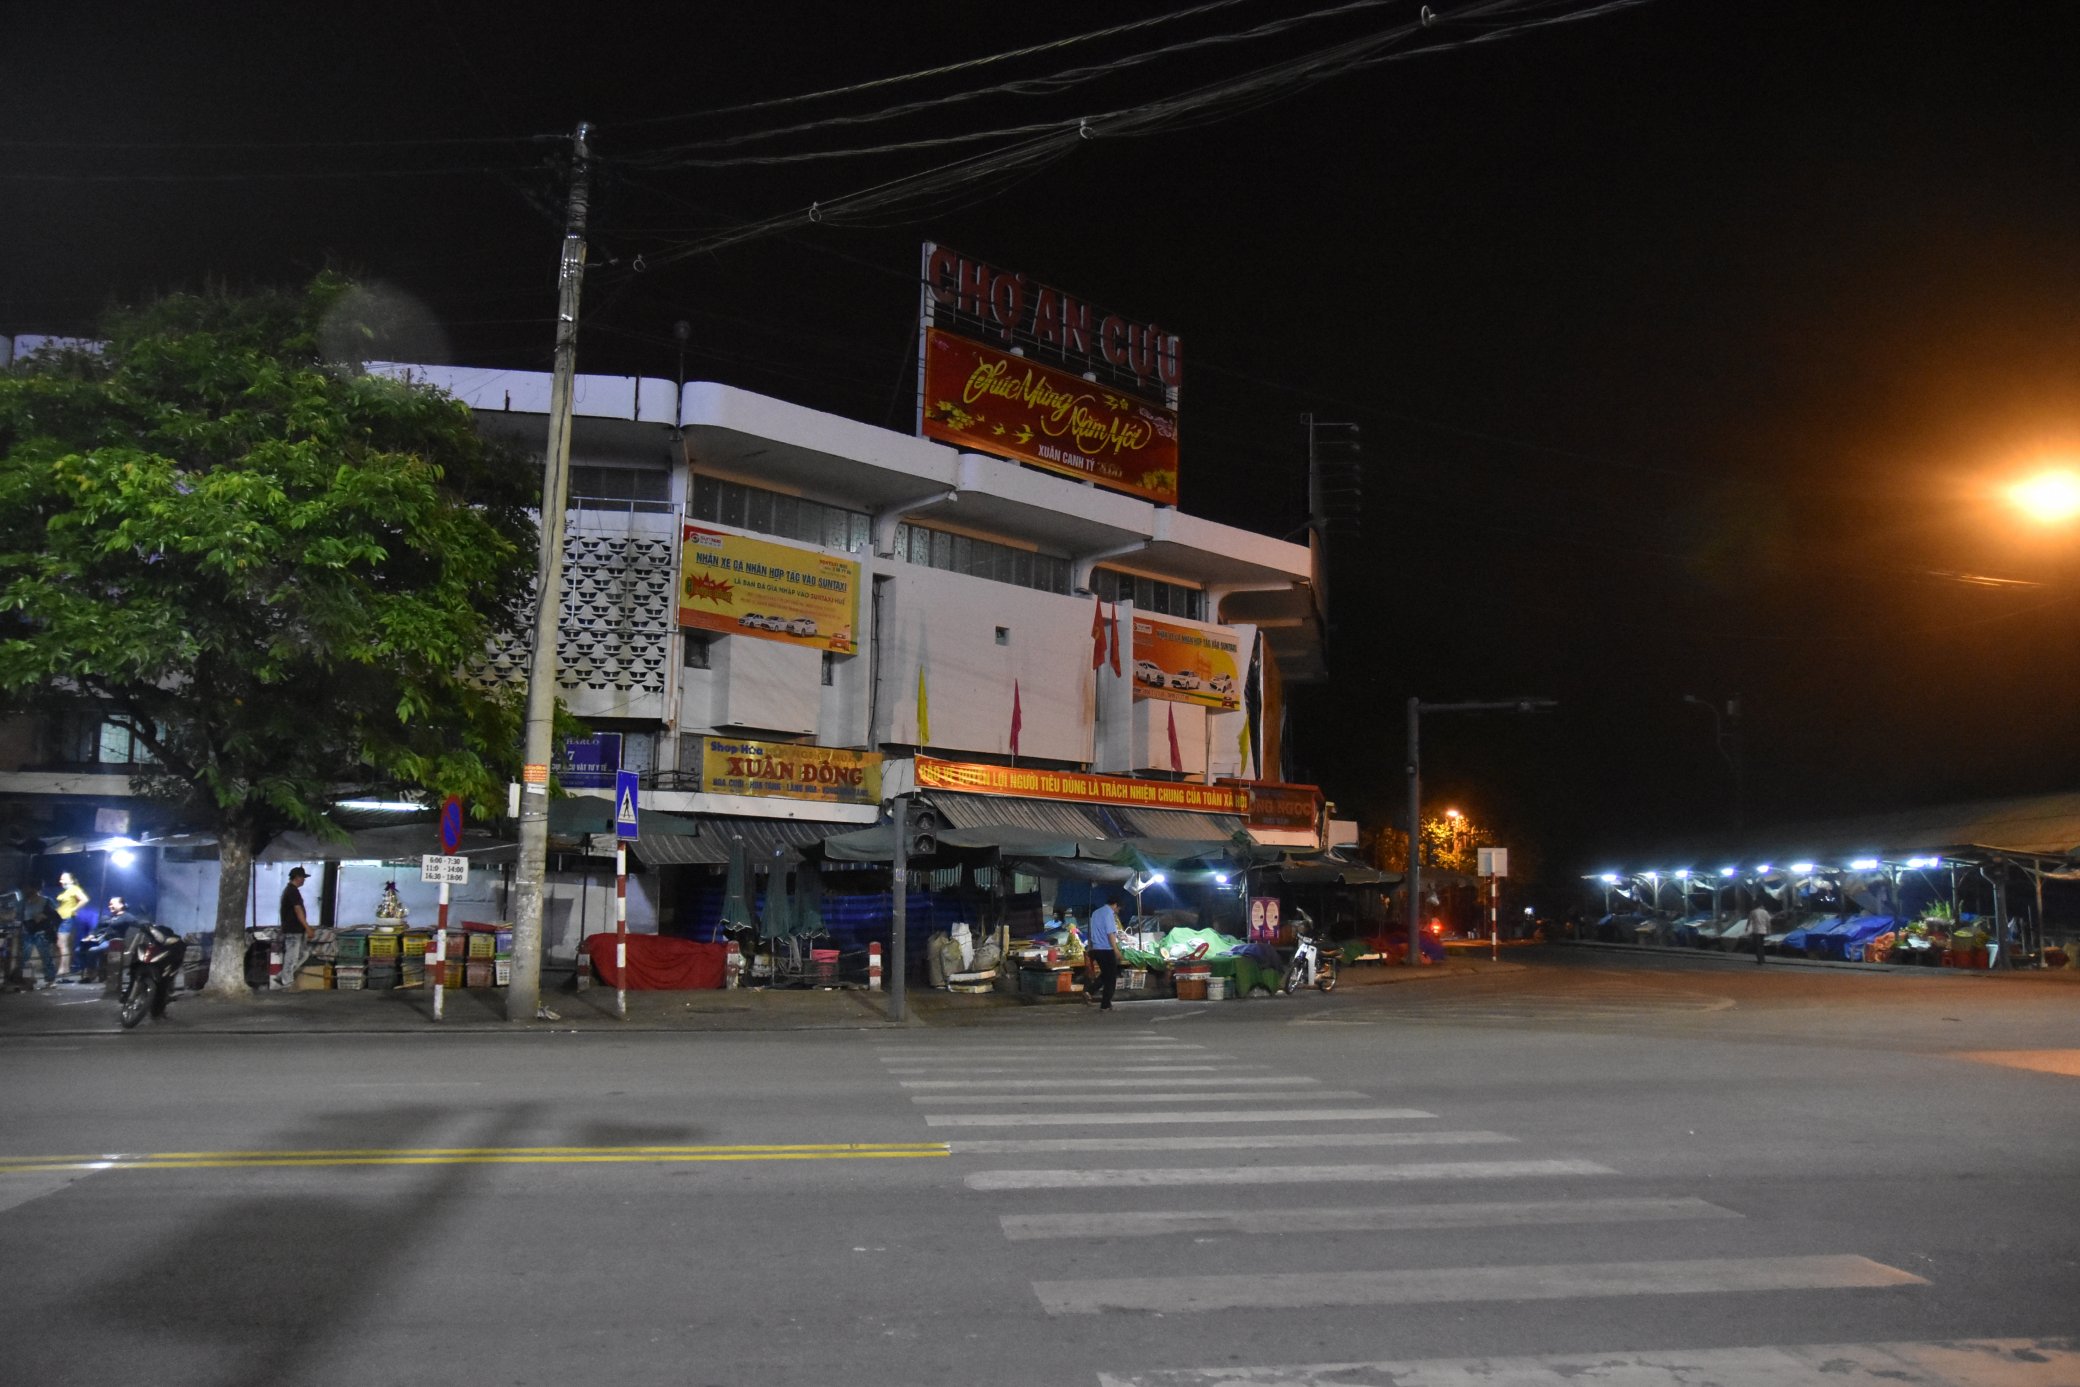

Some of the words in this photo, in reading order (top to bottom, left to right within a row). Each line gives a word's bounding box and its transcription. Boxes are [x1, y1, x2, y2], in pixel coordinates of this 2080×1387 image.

[926, 246, 1029, 340] CHỢ
[1030, 287, 1092, 354] AN
[1099, 312, 1184, 388] CỰU
[963, 356, 1021, 404] Chúc
[1015, 367, 1093, 422] Mừng
[1104, 416, 1152, 455] Mới
[1038, 444, 1062, 463] XUÂN
[1063, 450, 1085, 470] CANH
[721, 557, 731, 570] XE
[818, 576, 847, 593] SUNTAXI
[711, 741, 738, 754] Shop
[725, 754, 794, 779] XUÂN
[1010, 771, 1039, 791] NGƯỜI
[1041, 774, 1061, 793] TIÊU
[1062, 776, 1087, 796] DÙNG
[1088, 778, 1099, 797] LÀ
[1101, 780, 1128, 798] TRÁCH
[1129, 784, 1156, 804] NHIỆM
[1157, 787, 1185, 804] CHUNG
[1186, 787, 1202, 805] CỦA
[1202, 789, 1223, 807] TOÀN
[1234, 792, 1248, 812] HỘI
[425, 872, 442, 880] 16:30
[448, 857, 461, 865] 7:30
